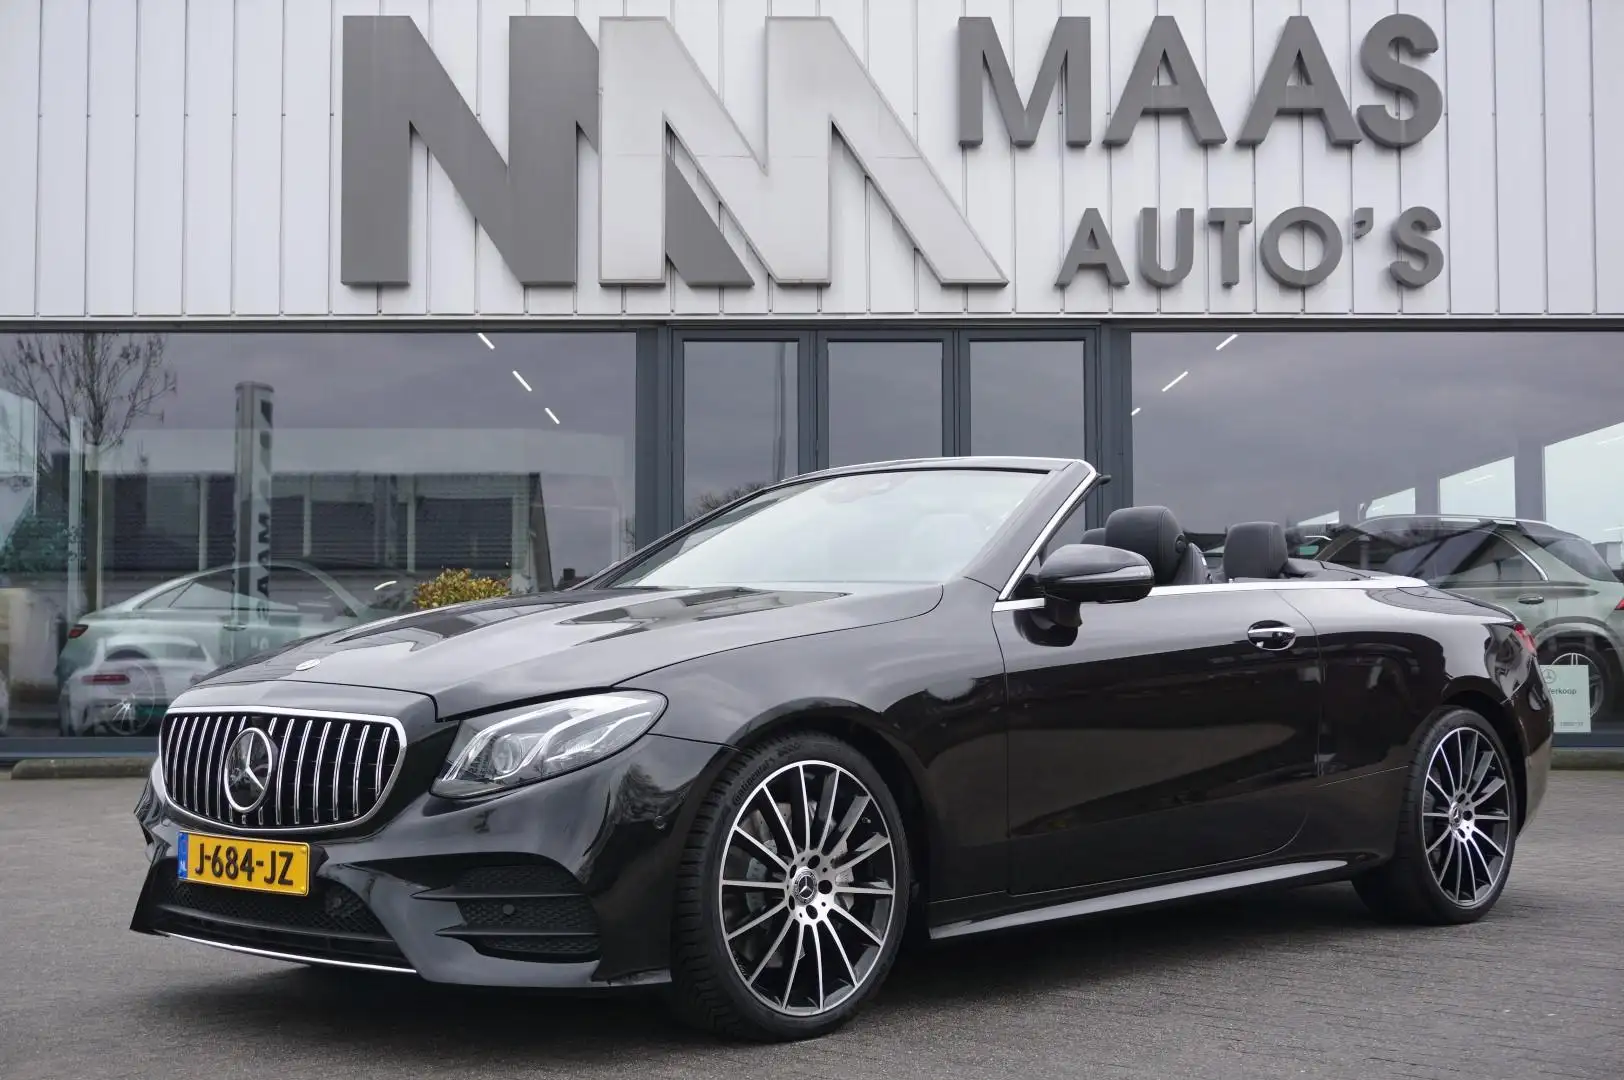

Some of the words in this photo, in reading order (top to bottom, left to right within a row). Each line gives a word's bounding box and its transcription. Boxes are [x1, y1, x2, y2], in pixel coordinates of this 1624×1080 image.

[957, 13, 1443, 148] MAAS
[1054, 205, 1444, 288] AUTO'S
[195, 843, 294, 885] J-684-JZ
